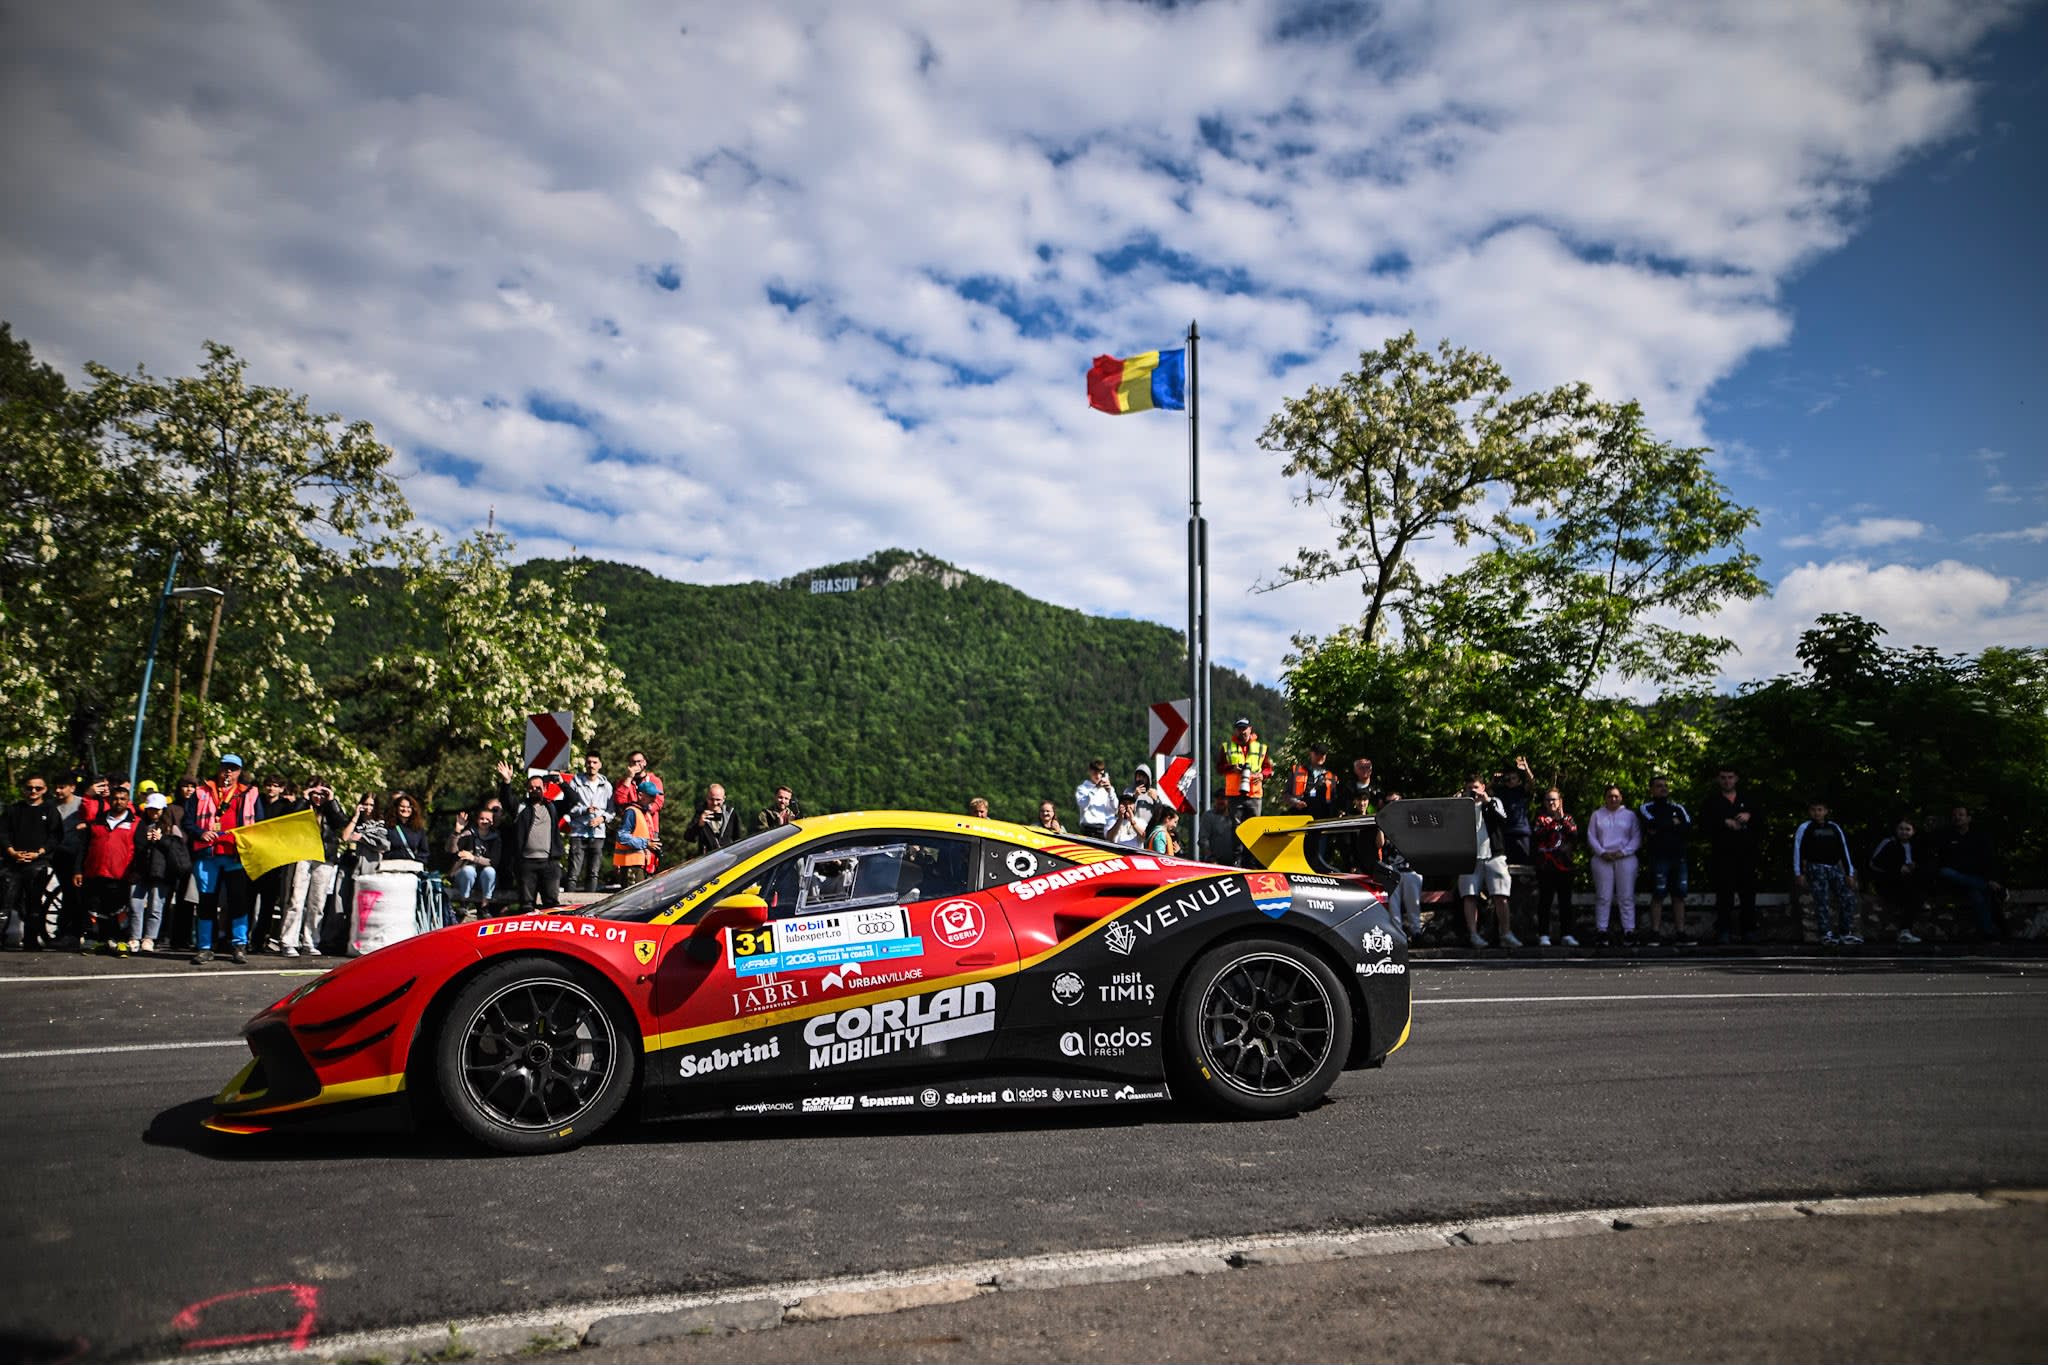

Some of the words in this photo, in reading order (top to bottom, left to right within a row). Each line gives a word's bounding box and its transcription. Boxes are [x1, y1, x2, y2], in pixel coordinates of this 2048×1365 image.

[1008, 857, 1129, 901] SPARTAN
[1290, 875, 1340, 886] CONSILIUL
[1134, 877, 1241, 935] VENUE
[856, 911, 893, 922] TESS
[504, 920, 575, 933] BENEA
[580, 926, 600, 938] R.
[605, 927, 627, 942] 01
[785, 920, 825, 933] Mobil
[786, 930, 842, 943] lubexpert.ro
[947, 930, 978, 942] EGERIA
[735, 931, 773, 956] 31
[785, 952, 816, 966] 2026
[1356, 959, 1405, 976] MAXAGRO
[849, 968, 923, 989] URBANVILLAGE
[1112, 972, 1141, 984] visit
[732, 980, 808, 1015] JABRI
[753, 1000, 791, 1012] PROPERTIES
[803, 981, 997, 1047] CORLAN
[1094, 1026, 1153, 1047] ados
[809, 1027, 921, 1071] MOBILITY
[1094, 1048, 1125, 1057] FRESH
[679, 1036, 781, 1078] Sabrini
[945, 1091, 997, 1104] Sabrini
[1019, 1087, 1048, 1098] ados
[1064, 1088, 1109, 1099] VENUE
[802, 1095, 855, 1107] CORLAN
[860, 1095, 914, 1107] SPARTAN
[802, 1104, 833, 1112] MOBILITY
